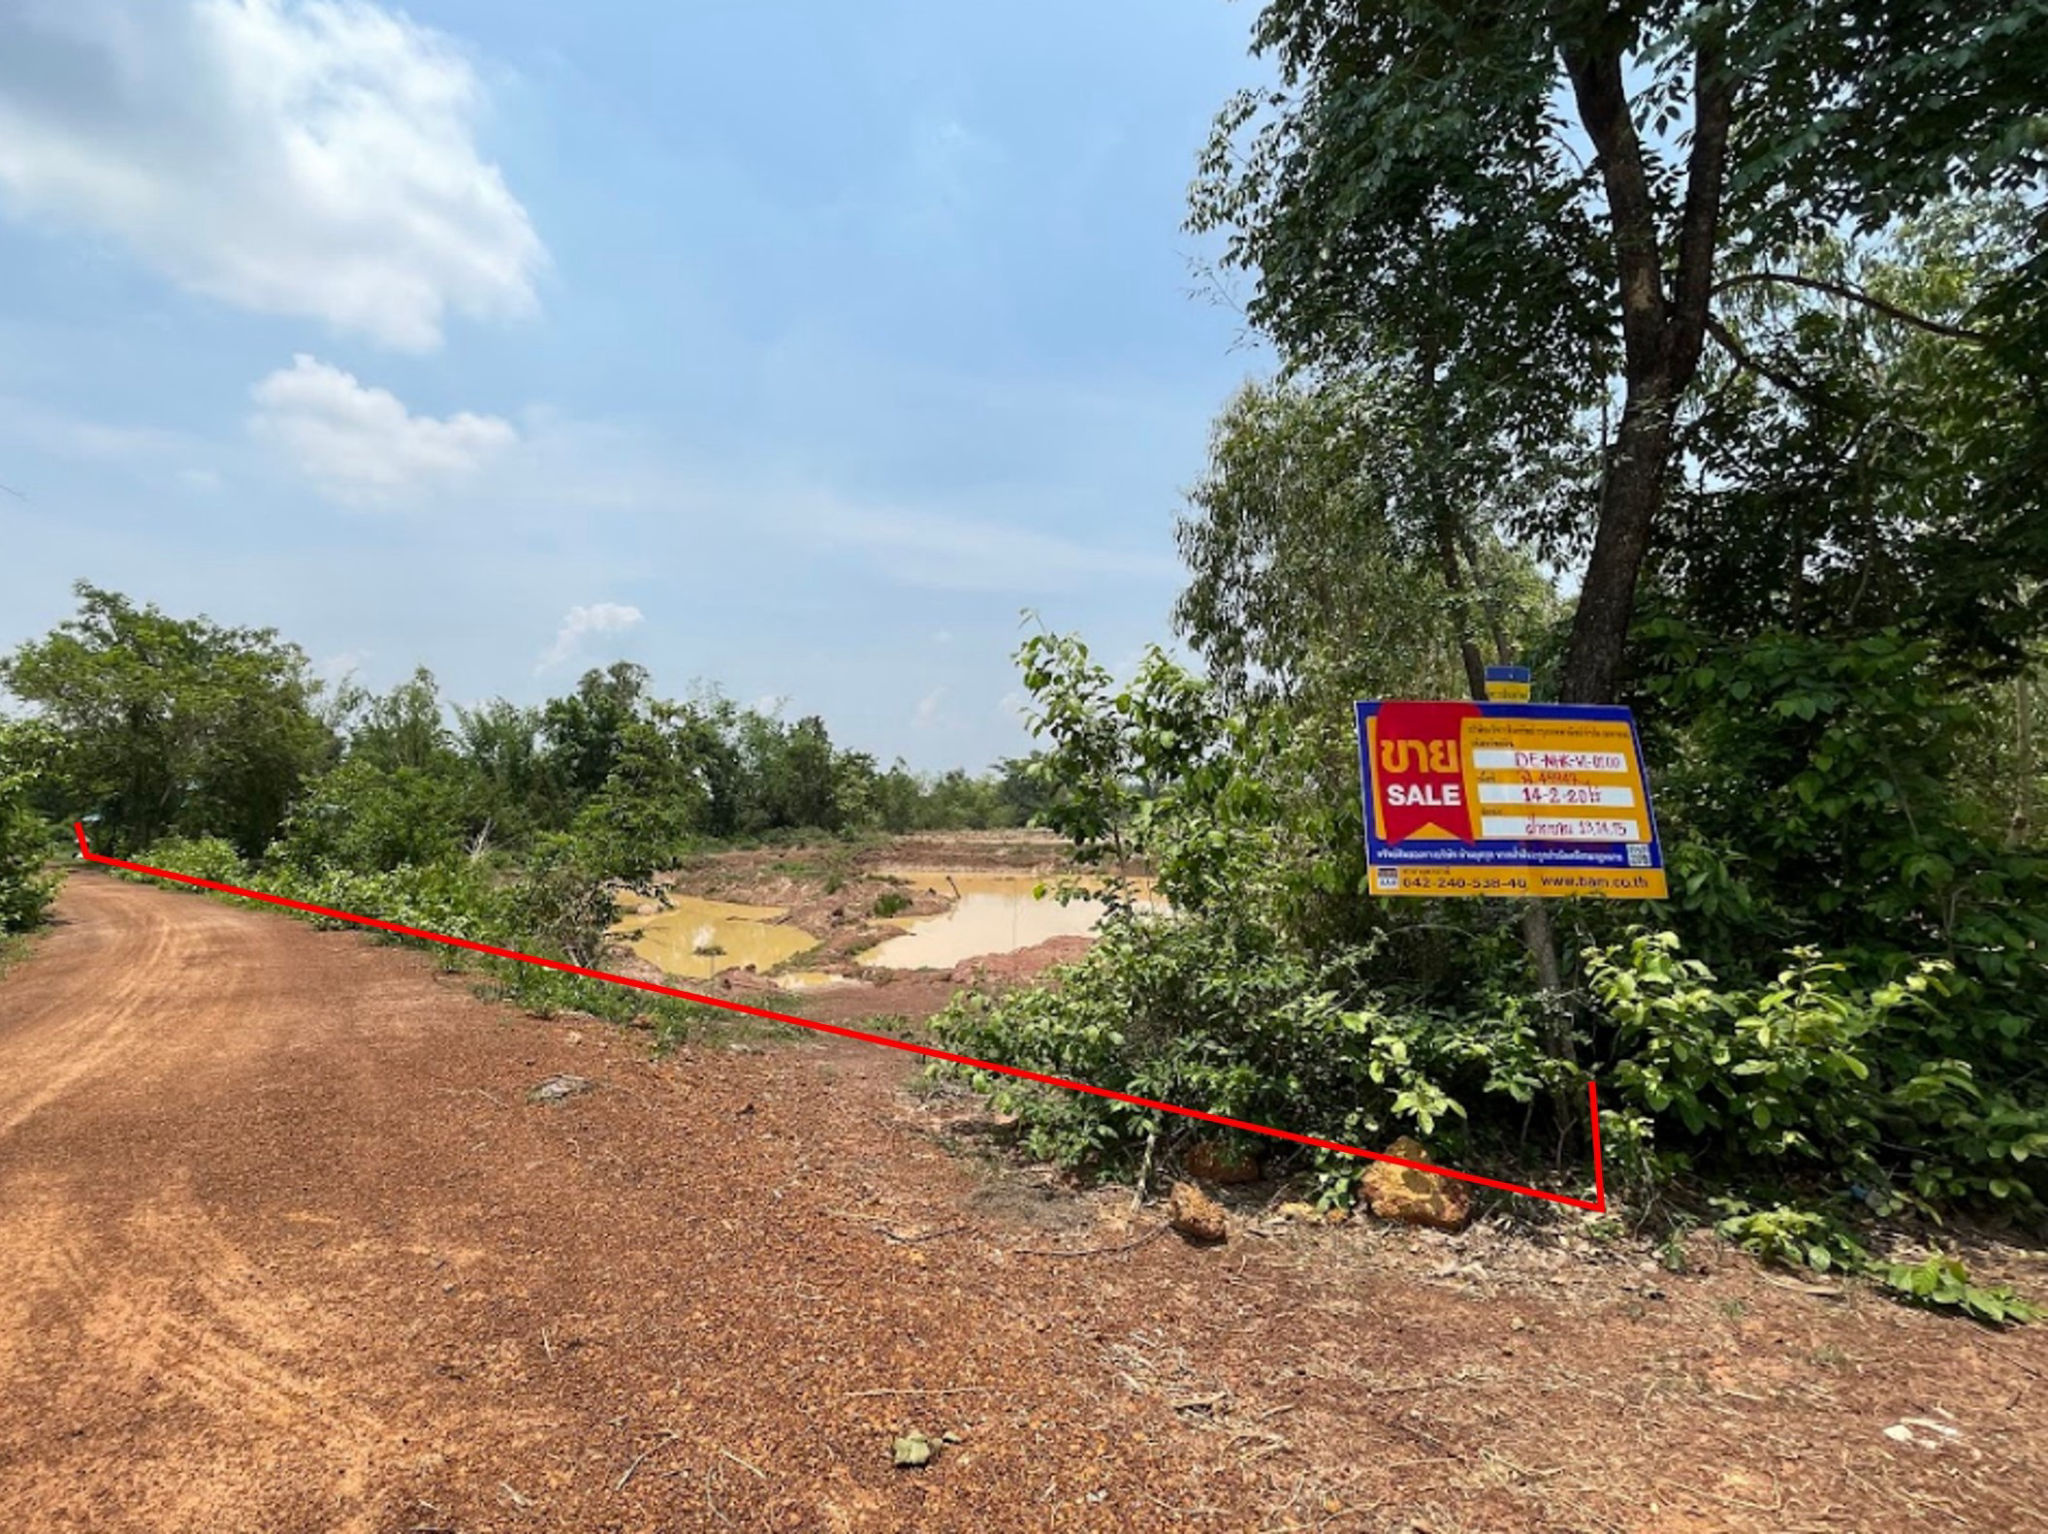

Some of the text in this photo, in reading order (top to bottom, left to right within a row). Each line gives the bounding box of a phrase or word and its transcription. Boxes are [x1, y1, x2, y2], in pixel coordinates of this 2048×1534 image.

[1380, 739, 1459, 773] ขาย
[1387, 783, 1461, 806] SALE
[1540, 876, 1649, 889] www.bam.co.th
